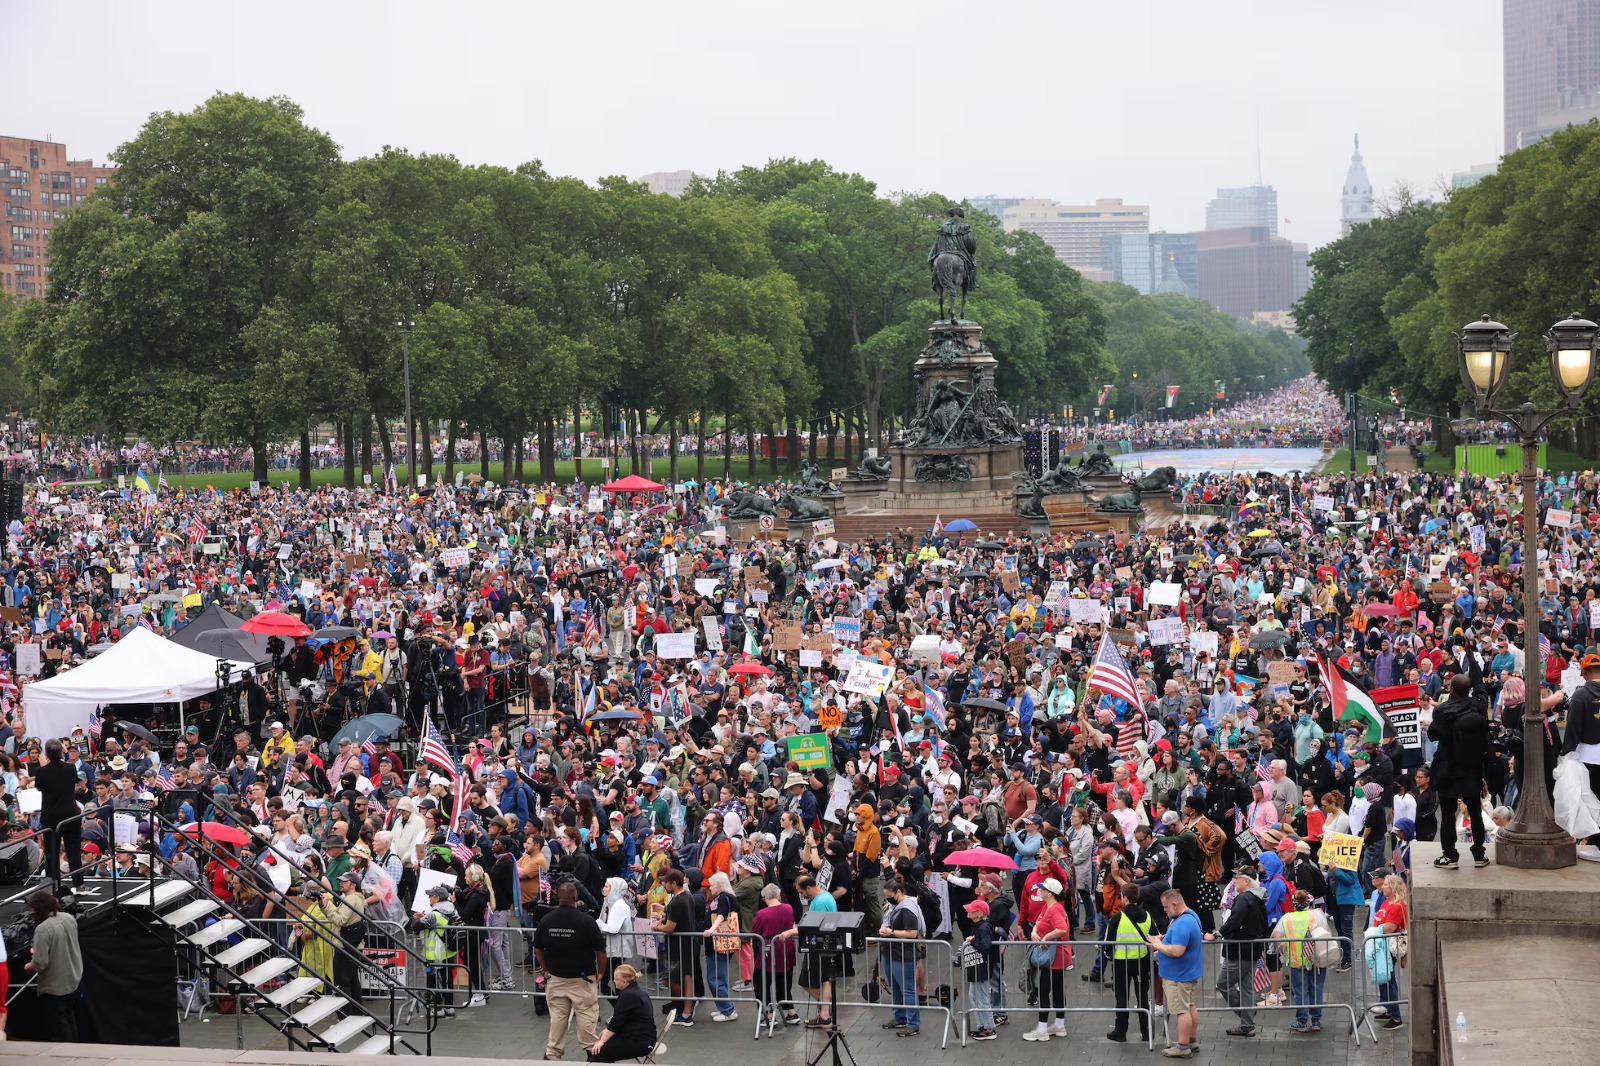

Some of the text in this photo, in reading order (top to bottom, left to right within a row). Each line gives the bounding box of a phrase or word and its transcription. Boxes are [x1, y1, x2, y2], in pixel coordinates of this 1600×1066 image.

[445, 557, 464, 566] PELT
[835, 622, 859, 631] DEMOCRACY
[822, 707, 837, 718] NO
[1390, 714, 1415, 722] CRACY
[1337, 846, 1357, 856] ICE
